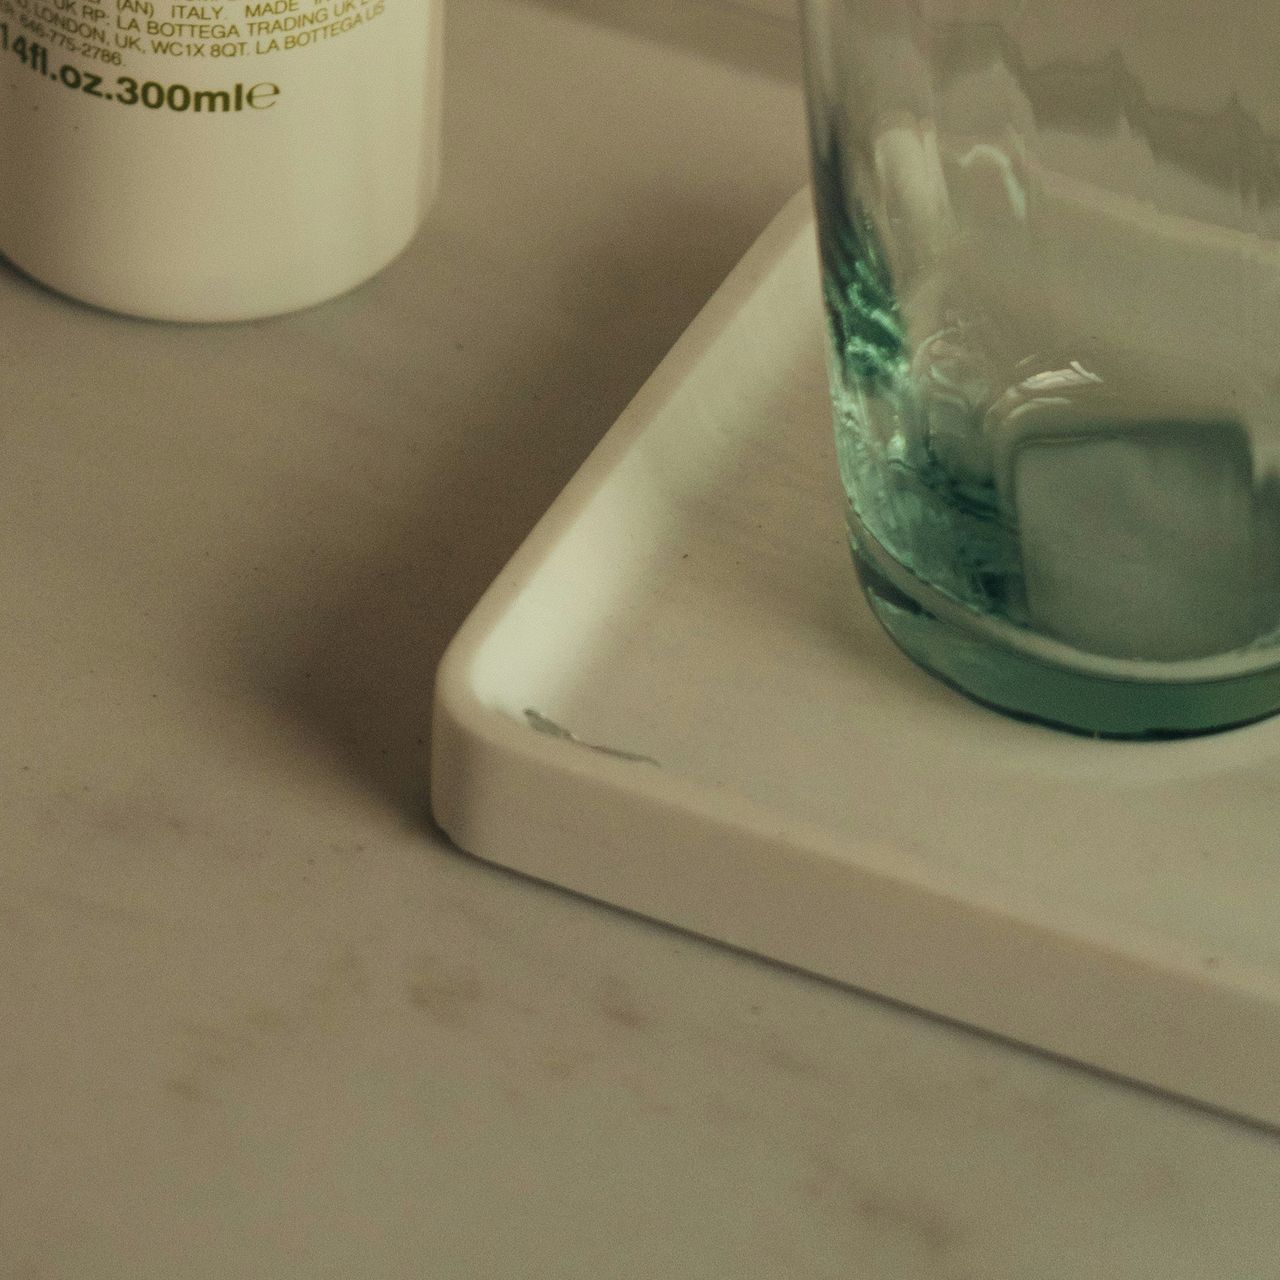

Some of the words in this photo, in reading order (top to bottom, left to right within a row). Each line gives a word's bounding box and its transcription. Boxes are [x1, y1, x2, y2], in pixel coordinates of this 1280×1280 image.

[116, 15, 140, 33] LA
[146, 21, 240, 39] BOTTEGA
[246, 6, 330, 37] TRADING
[256, 38, 280, 54] LA
[284, 11, 362, 50] BOTTEGA
